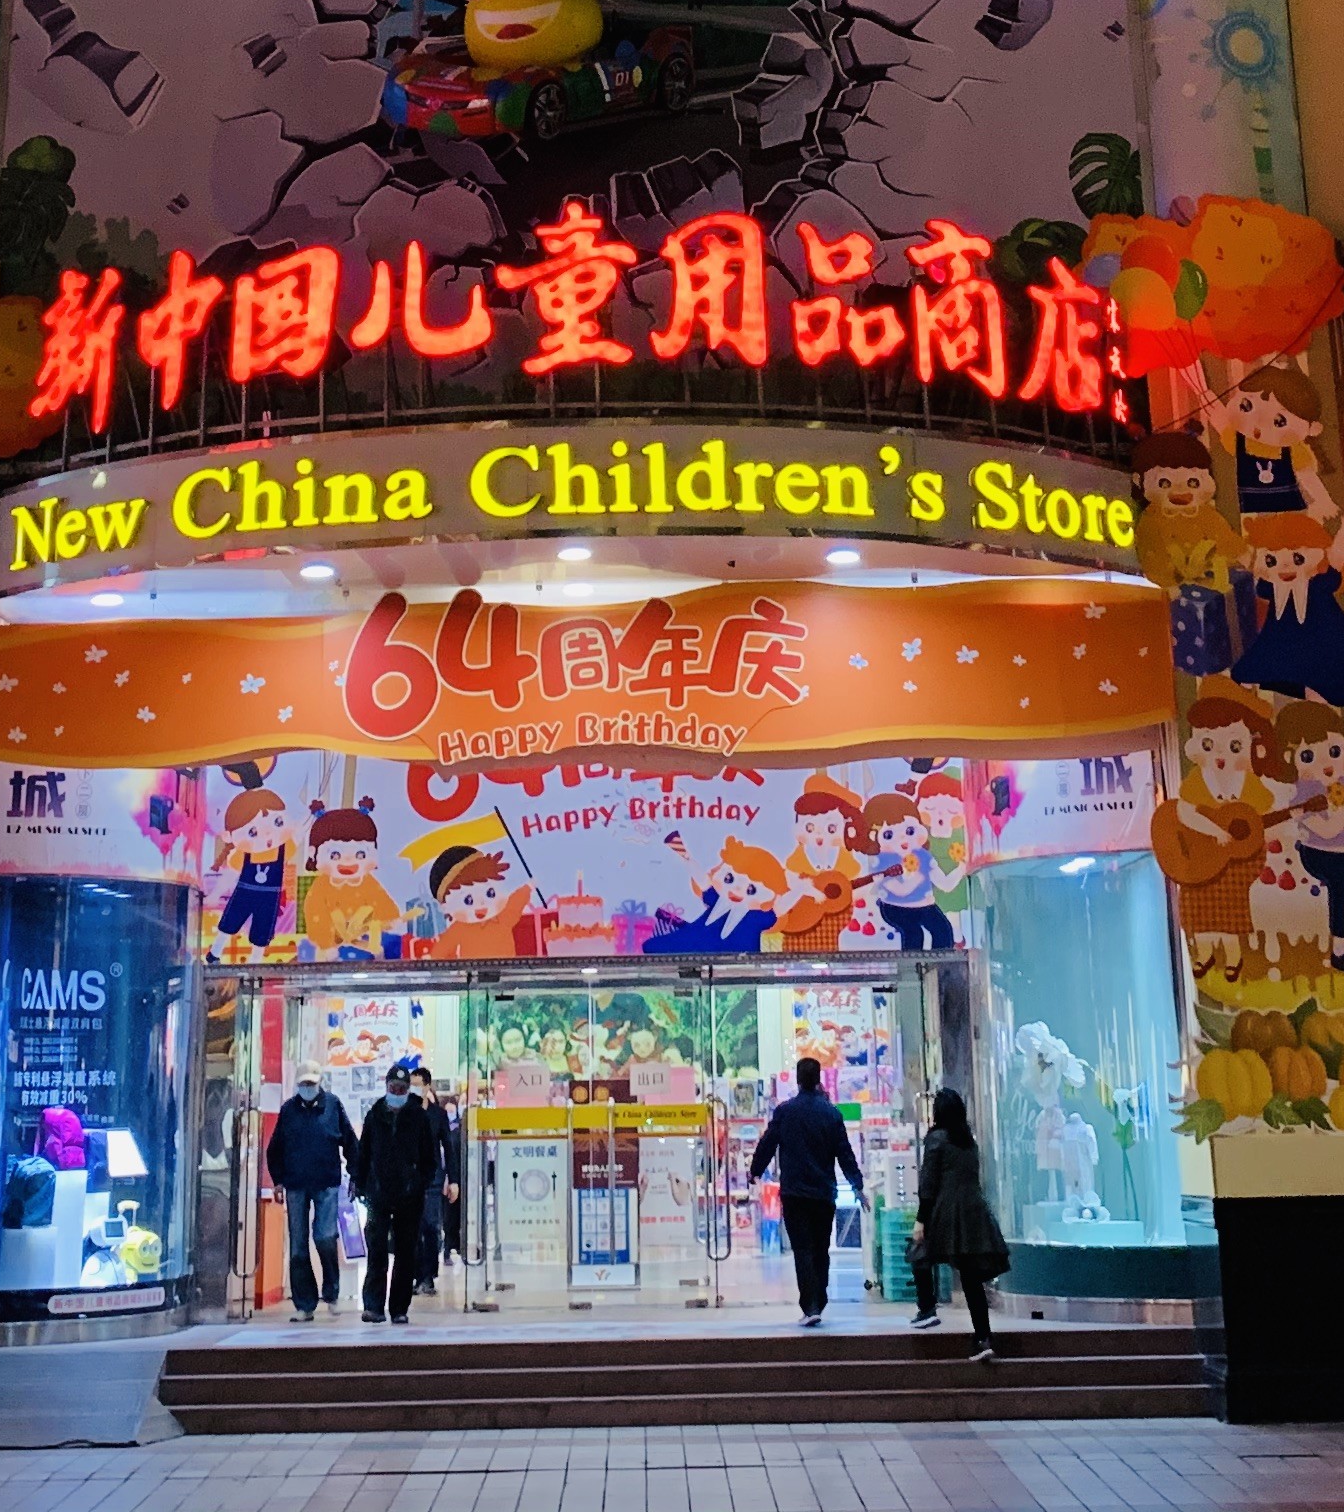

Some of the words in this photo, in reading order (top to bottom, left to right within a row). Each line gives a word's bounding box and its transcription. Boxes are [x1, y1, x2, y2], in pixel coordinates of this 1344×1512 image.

[29, 201, 1104, 434] 新中国儿童用品商店
[9, 496, 147, 572] New
[172, 458, 433, 539] China
[469, 439, 943, 524] Children's
[973, 461, 1136, 548] Store
[342, 587, 809, 741] 64周年庆
[437, 720, 563, 766] Happy
[521, 802, 619, 839] Happy
[21, 967, 106, 1012] CAMS
[515, 1072, 543, 1087] 入口
[637, 1072, 665, 1087] 出口
